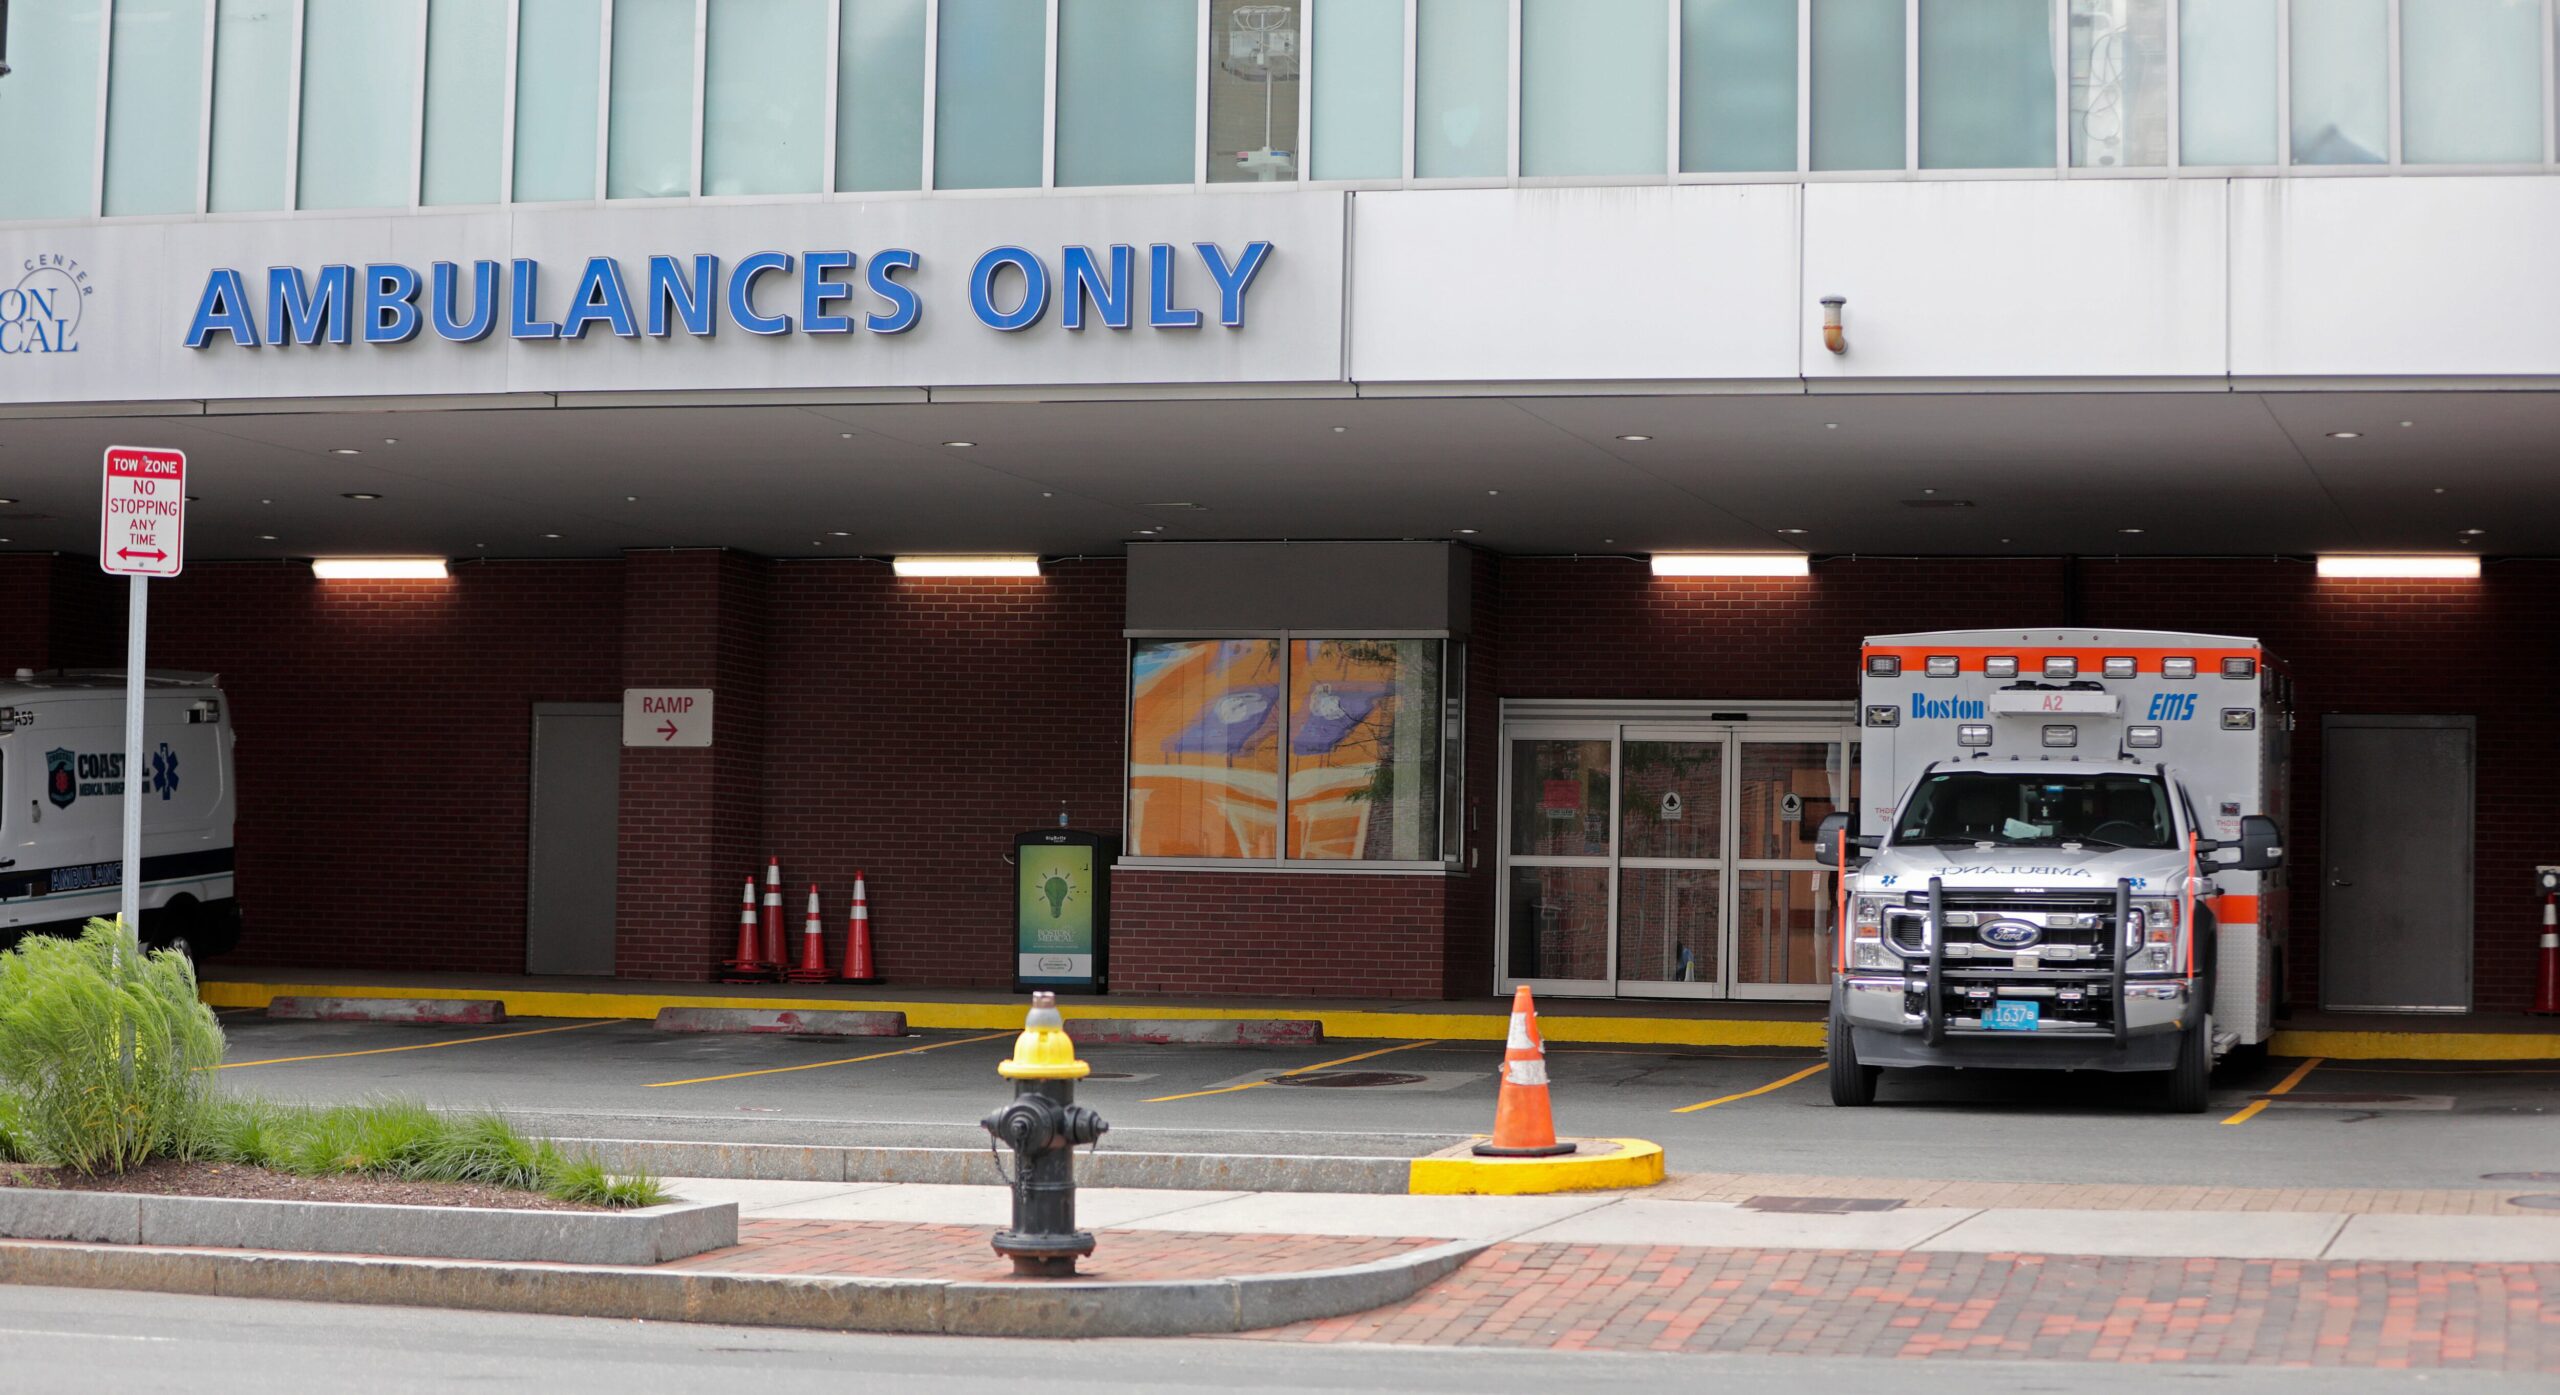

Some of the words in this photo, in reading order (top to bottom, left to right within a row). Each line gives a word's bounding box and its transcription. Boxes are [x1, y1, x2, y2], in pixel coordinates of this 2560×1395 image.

[24, 253, 93, 296] CENTER
[183, 247, 923, 349] AMBULANCES
[967, 240, 1275, 333] ONLY
[113, 458, 139, 471] TOW
[145, 460, 177, 474] ZONE
[133, 480, 155, 495] NO
[110, 498, 177, 516] STOPPING
[129, 519, 156, 530] ANY
[129, 533, 156, 545] TIME
[643, 697, 694, 713] RAMP
[1912, 692, 1984, 719] Boston
[2042, 695, 2063, 711] A2
[2147, 693, 2198, 720] EMS
[14, 711, 34, 726] A59
[51, 862, 123, 891] AMBULANC
[1993, 927, 2024, 941] Ford
